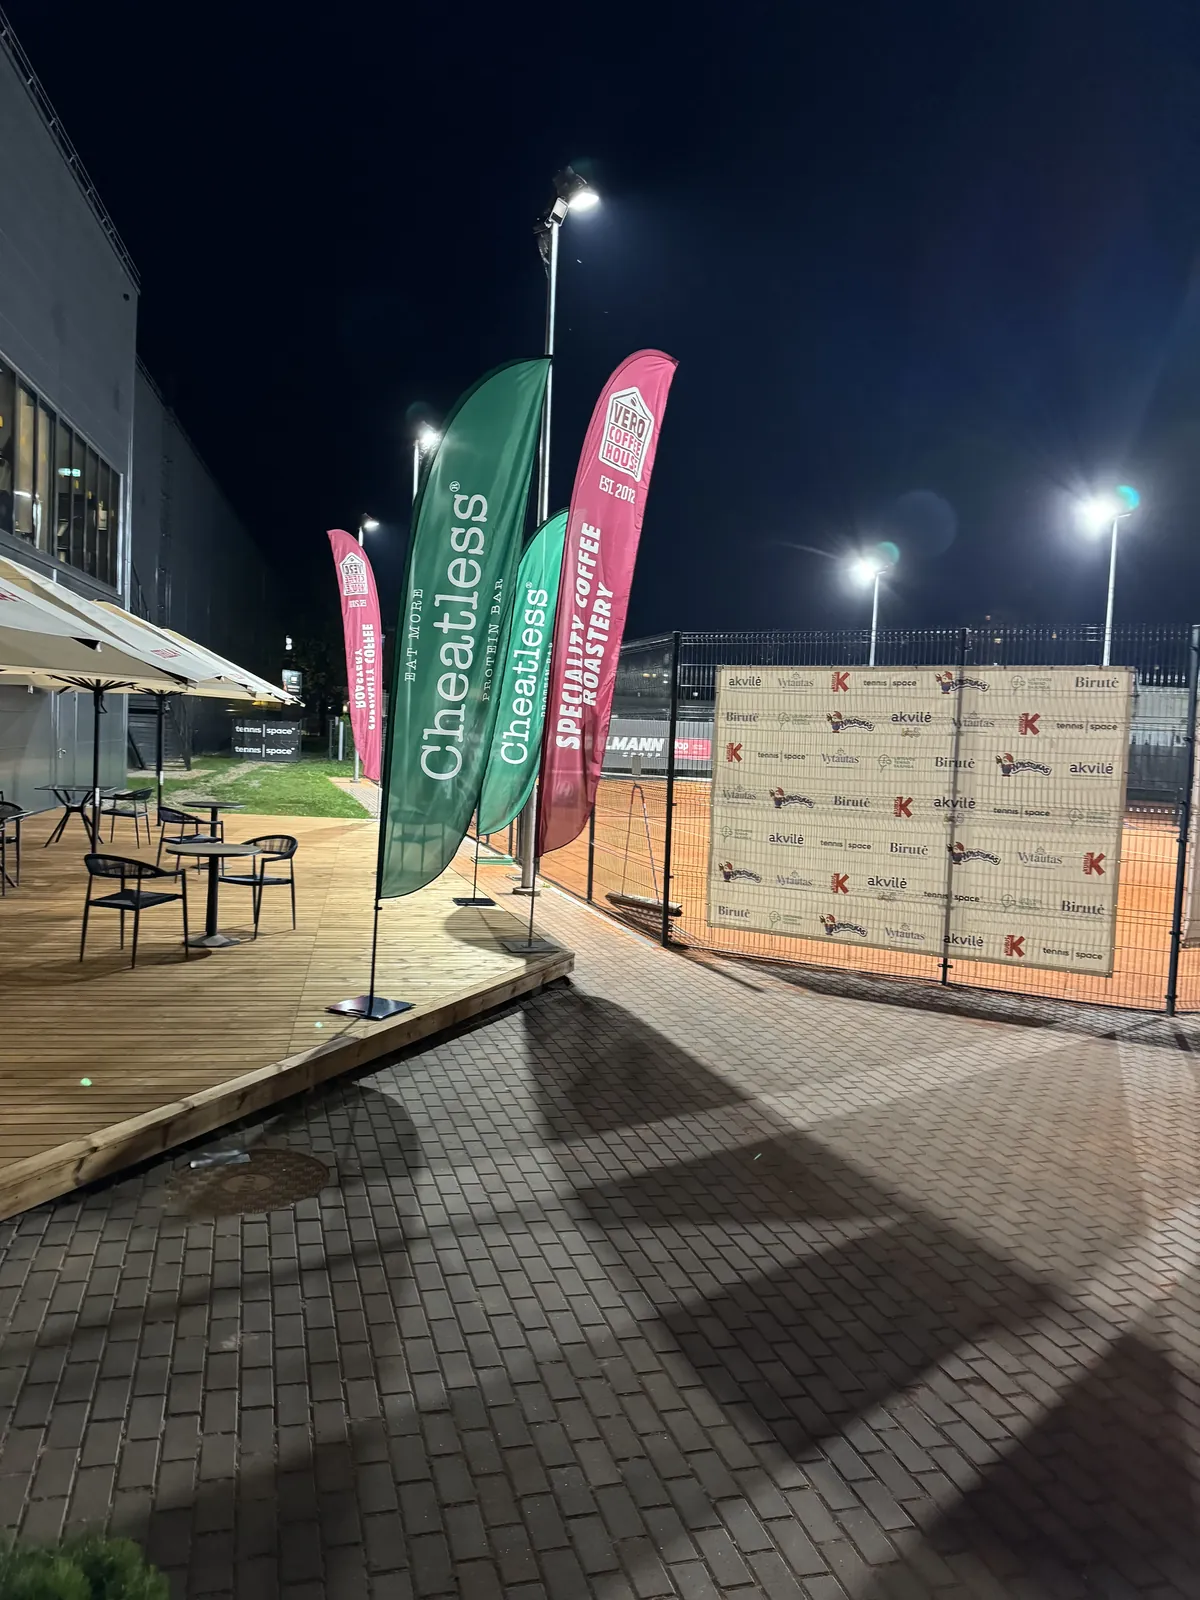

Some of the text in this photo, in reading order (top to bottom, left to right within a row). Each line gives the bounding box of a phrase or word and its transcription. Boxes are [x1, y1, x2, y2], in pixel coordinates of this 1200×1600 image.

[614, 403, 646, 438] VERO
[608, 425, 642, 457] COFFEE
[404, 588, 423, 682] EAT MORE
[483, 578, 503, 702] PROTEIN BAR
[556, 522, 601, 750] SPECIALITY COFFEE
[582, 582, 613, 706] ROASTERY
[728, 676, 762, 687] akvilė
[892, 679, 917, 688] space
[1075, 676, 1119, 689] Birutė
[726, 712, 759, 722] Birutė
[891, 711, 932, 723] akvilė
[1056, 722, 1118, 732] tennis space
[784, 753, 806, 761] space
[934, 756, 975, 769] Birutė
[1069, 762, 1114, 774] akvilė
[834, 796, 870, 808] Birutė
[934, 798, 976, 810] akvilė
[993, 808, 1050, 818] tennis space
[768, 833, 804, 845] akvilė
[820, 840, 872, 850] tennis space
[890, 842, 928, 856] Birutė
[867, 876, 908, 889] akvilė
[924, 890, 980, 903] tennis space
[718, 906, 750, 918] Birutė
[1061, 900, 1105, 915] Birutė
[943, 933, 984, 947] akvilė
[1043, 948, 1103, 960] tennis space
